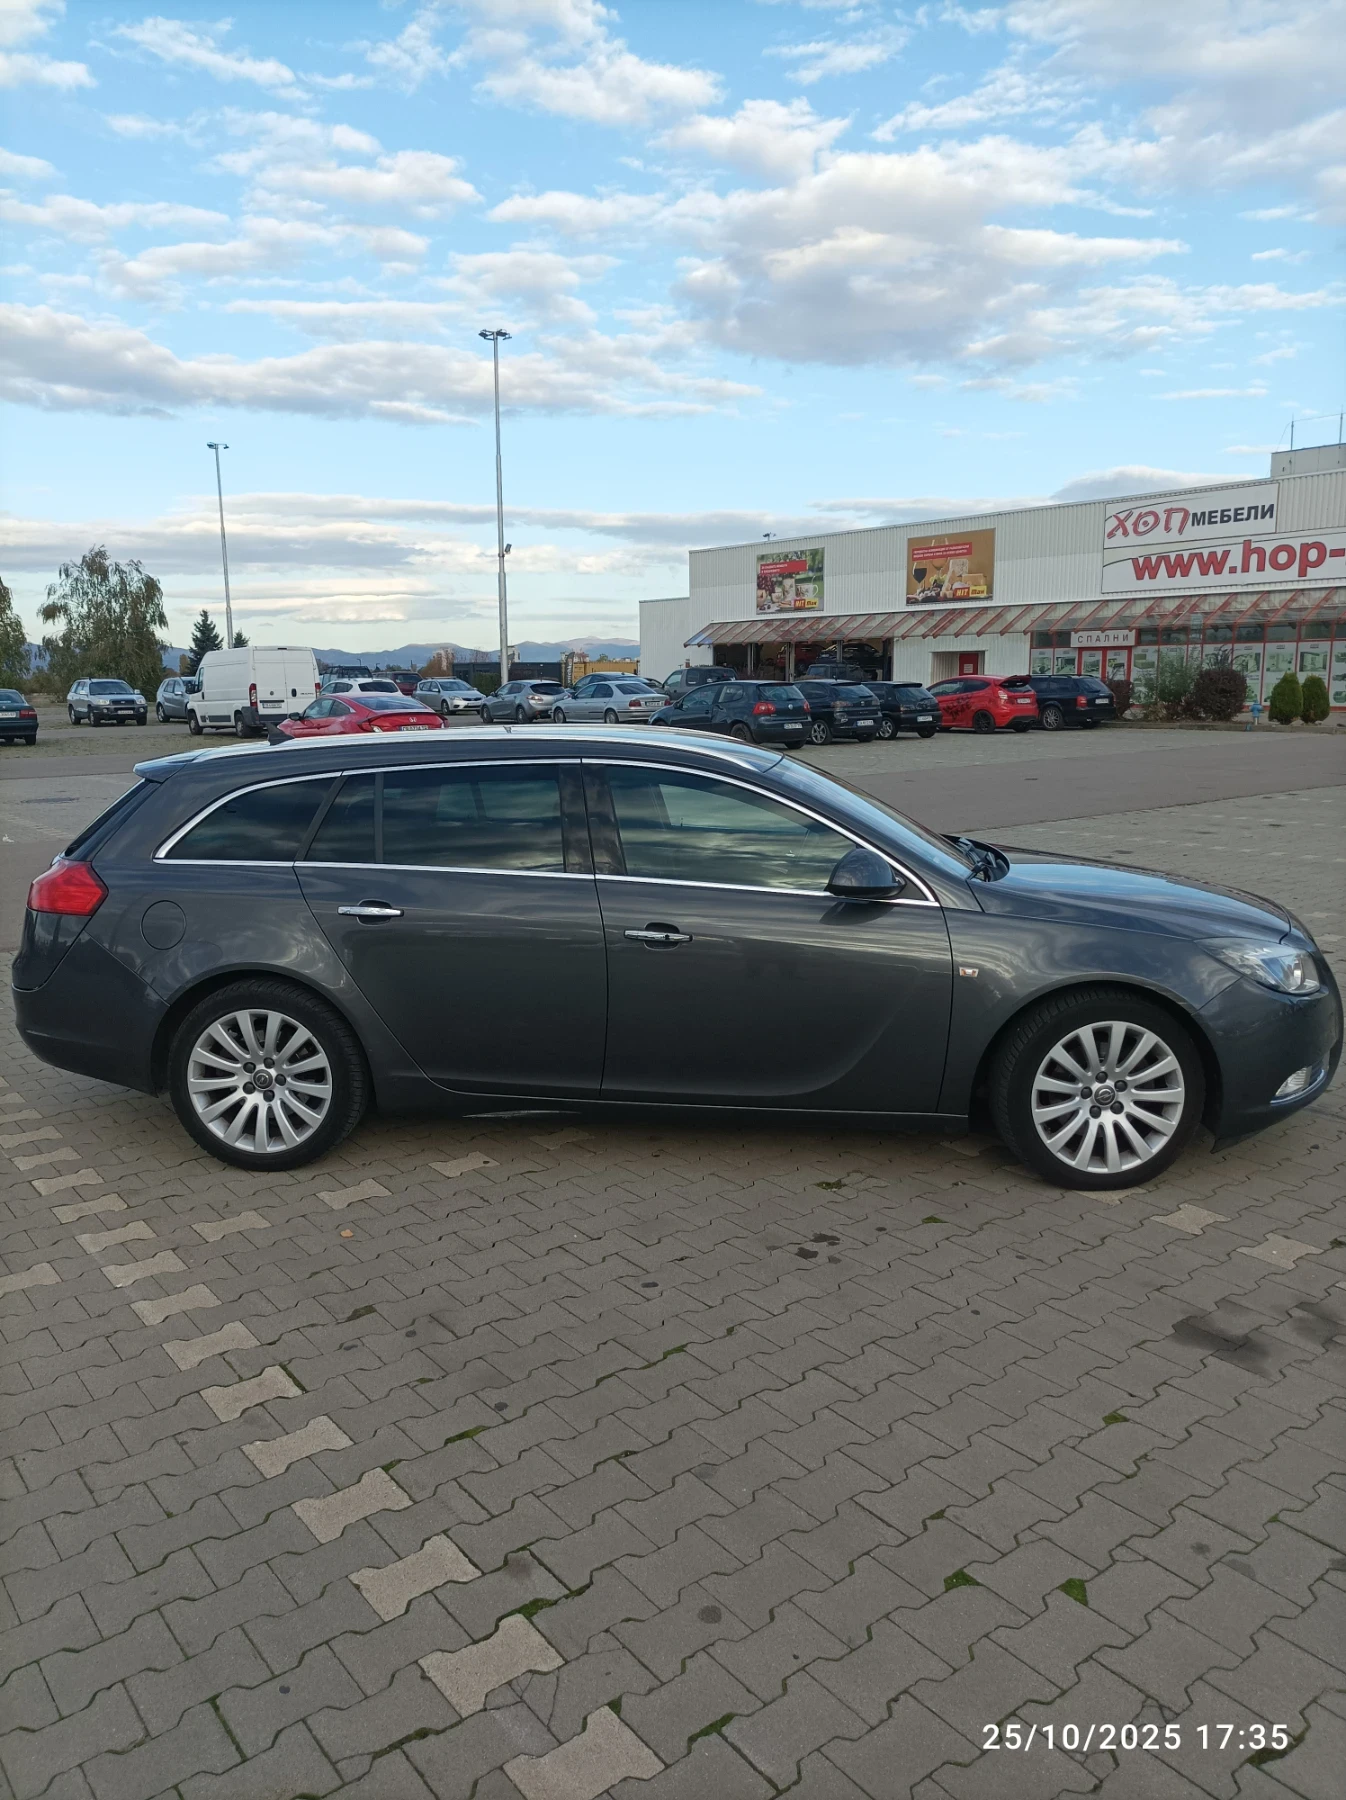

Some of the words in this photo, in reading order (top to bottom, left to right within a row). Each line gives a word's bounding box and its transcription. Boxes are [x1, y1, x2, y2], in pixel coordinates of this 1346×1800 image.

[1106, 508, 1190, 539] ХОП
[1191, 504, 1275, 527] МЕБЕЛИ
[1132, 540, 1346, 580] www.hop-
[1077, 634, 1129, 644] СПАЛНИ
